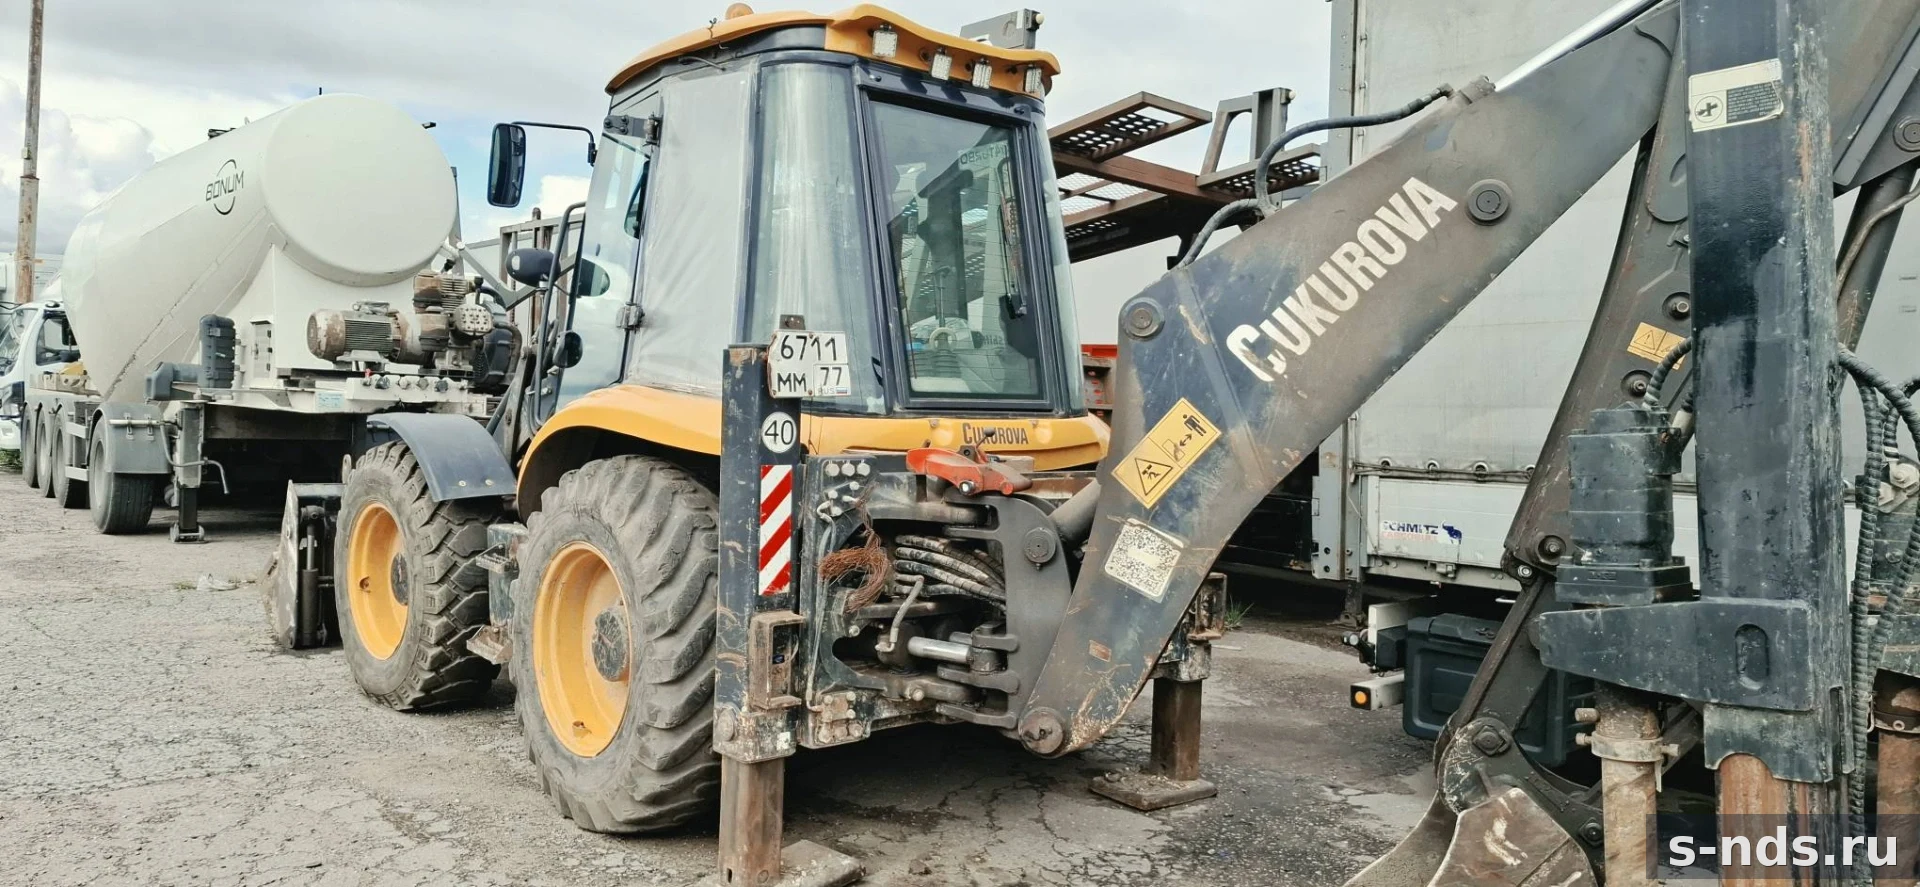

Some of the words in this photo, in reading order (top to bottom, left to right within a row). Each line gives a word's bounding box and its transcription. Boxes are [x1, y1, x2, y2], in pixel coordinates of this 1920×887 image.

[206, 170, 244, 202] BONUM
[1226, 177, 1458, 382] CUKUROVA
[780, 334, 837, 361] 6711
[820, 366, 842, 386] 77
[764, 420, 795, 446] 40
